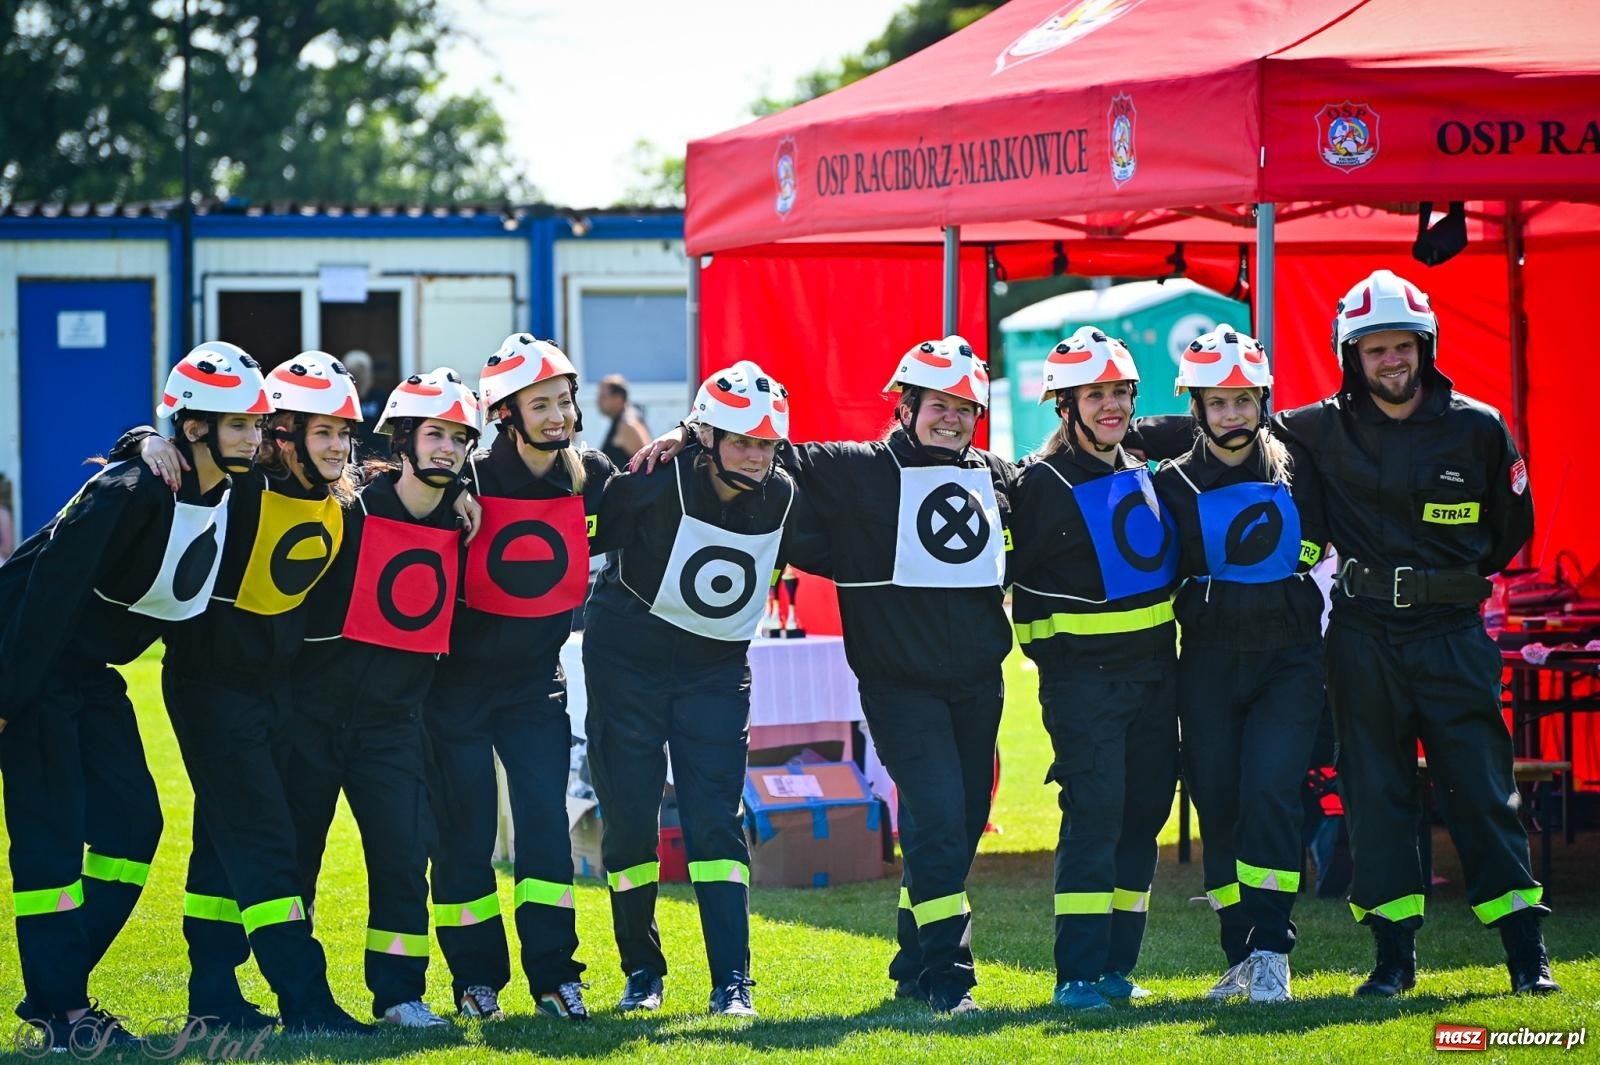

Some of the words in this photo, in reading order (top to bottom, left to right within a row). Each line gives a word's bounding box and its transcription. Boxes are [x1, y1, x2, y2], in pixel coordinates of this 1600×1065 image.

[1327, 105, 1367, 119] OSP
[1437, 120, 1524, 156] OSP
[1535, 119, 1600, 155] RA
[816, 154, 849, 197] OSP
[853, 128, 1090, 195] RACIBÓRZ-MARKOWICE
